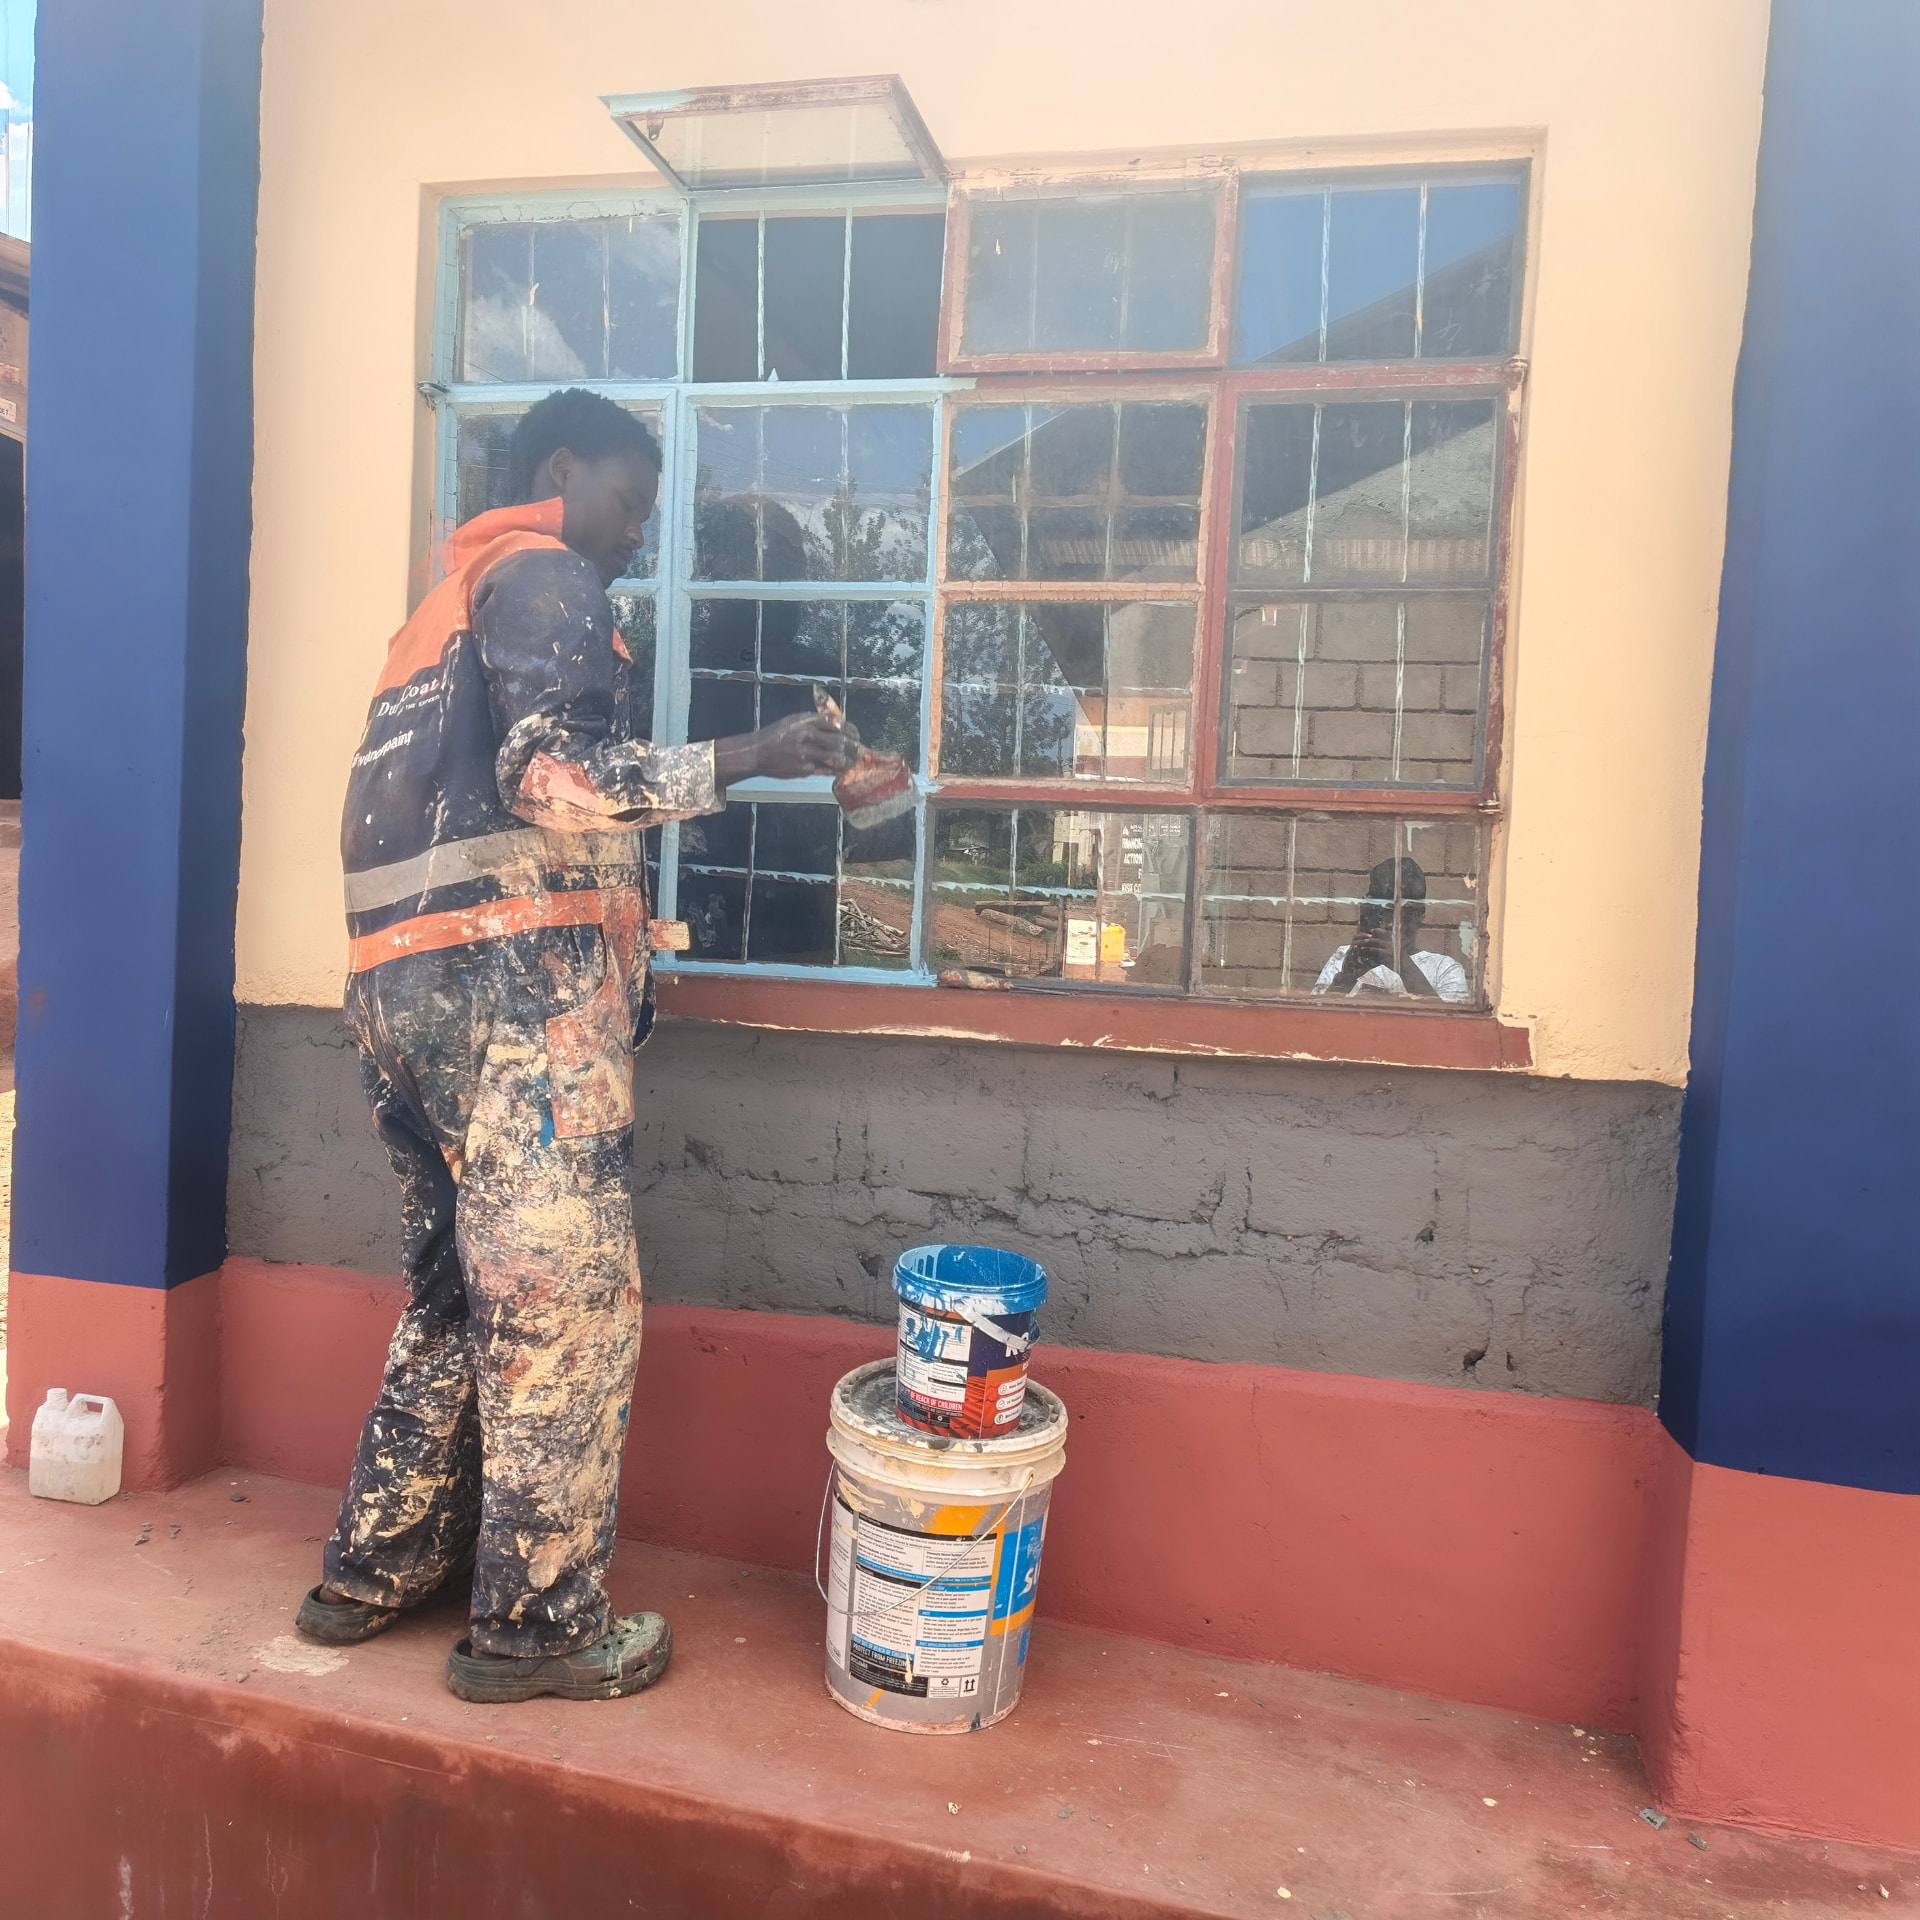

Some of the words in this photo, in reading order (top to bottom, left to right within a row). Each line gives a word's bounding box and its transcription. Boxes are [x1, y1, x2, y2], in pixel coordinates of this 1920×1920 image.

[915, 1392, 930, 1404] REACH
[930, 1398, 937, 1407] OF
[938, 1400, 963, 1411] CHILDREN
[871, 1650, 886, 1661] FROM
[886, 1655, 909, 1668] FREEZIN
